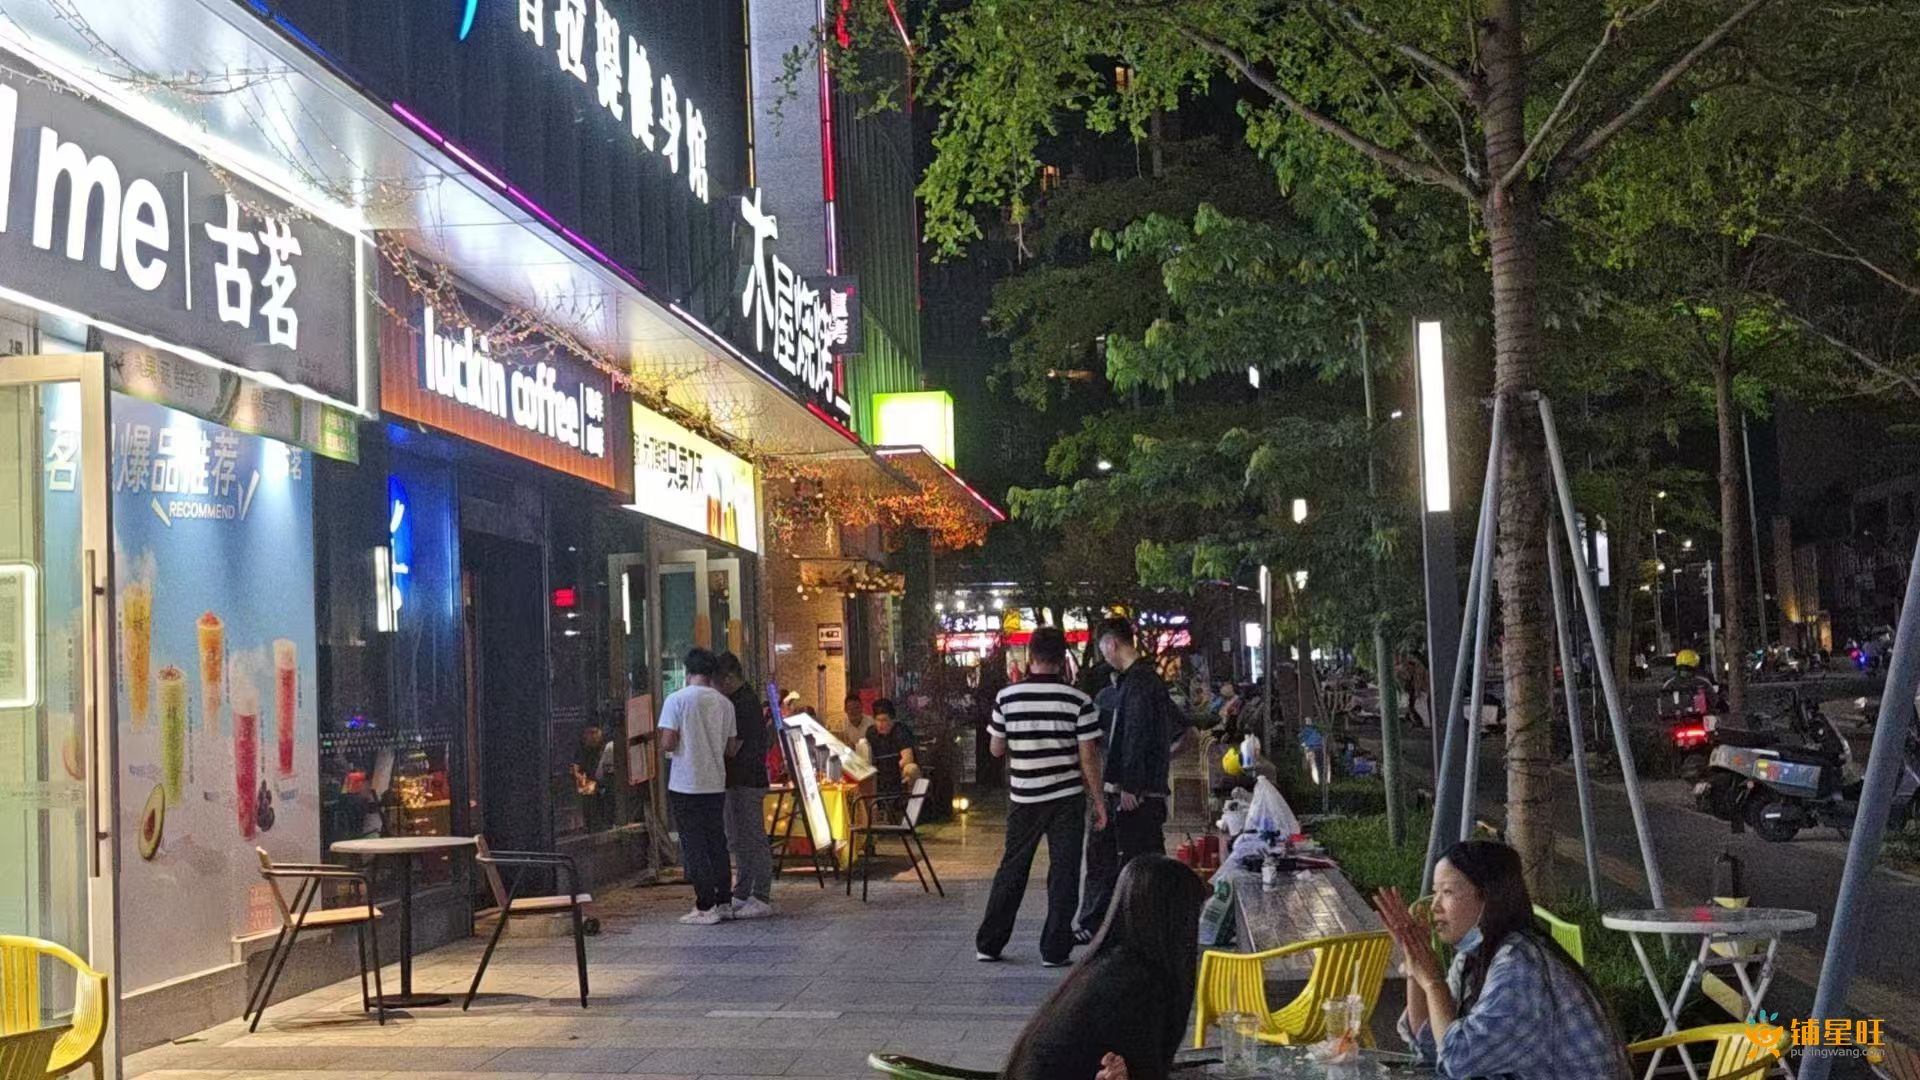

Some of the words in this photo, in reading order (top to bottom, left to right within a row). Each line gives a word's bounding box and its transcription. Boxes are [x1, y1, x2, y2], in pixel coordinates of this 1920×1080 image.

[204, 193, 302, 351] 古茗
[424, 304, 508, 420] luckin
[511, 362, 580, 448] coffee
[169, 501, 236, 520] RECOMMEND
